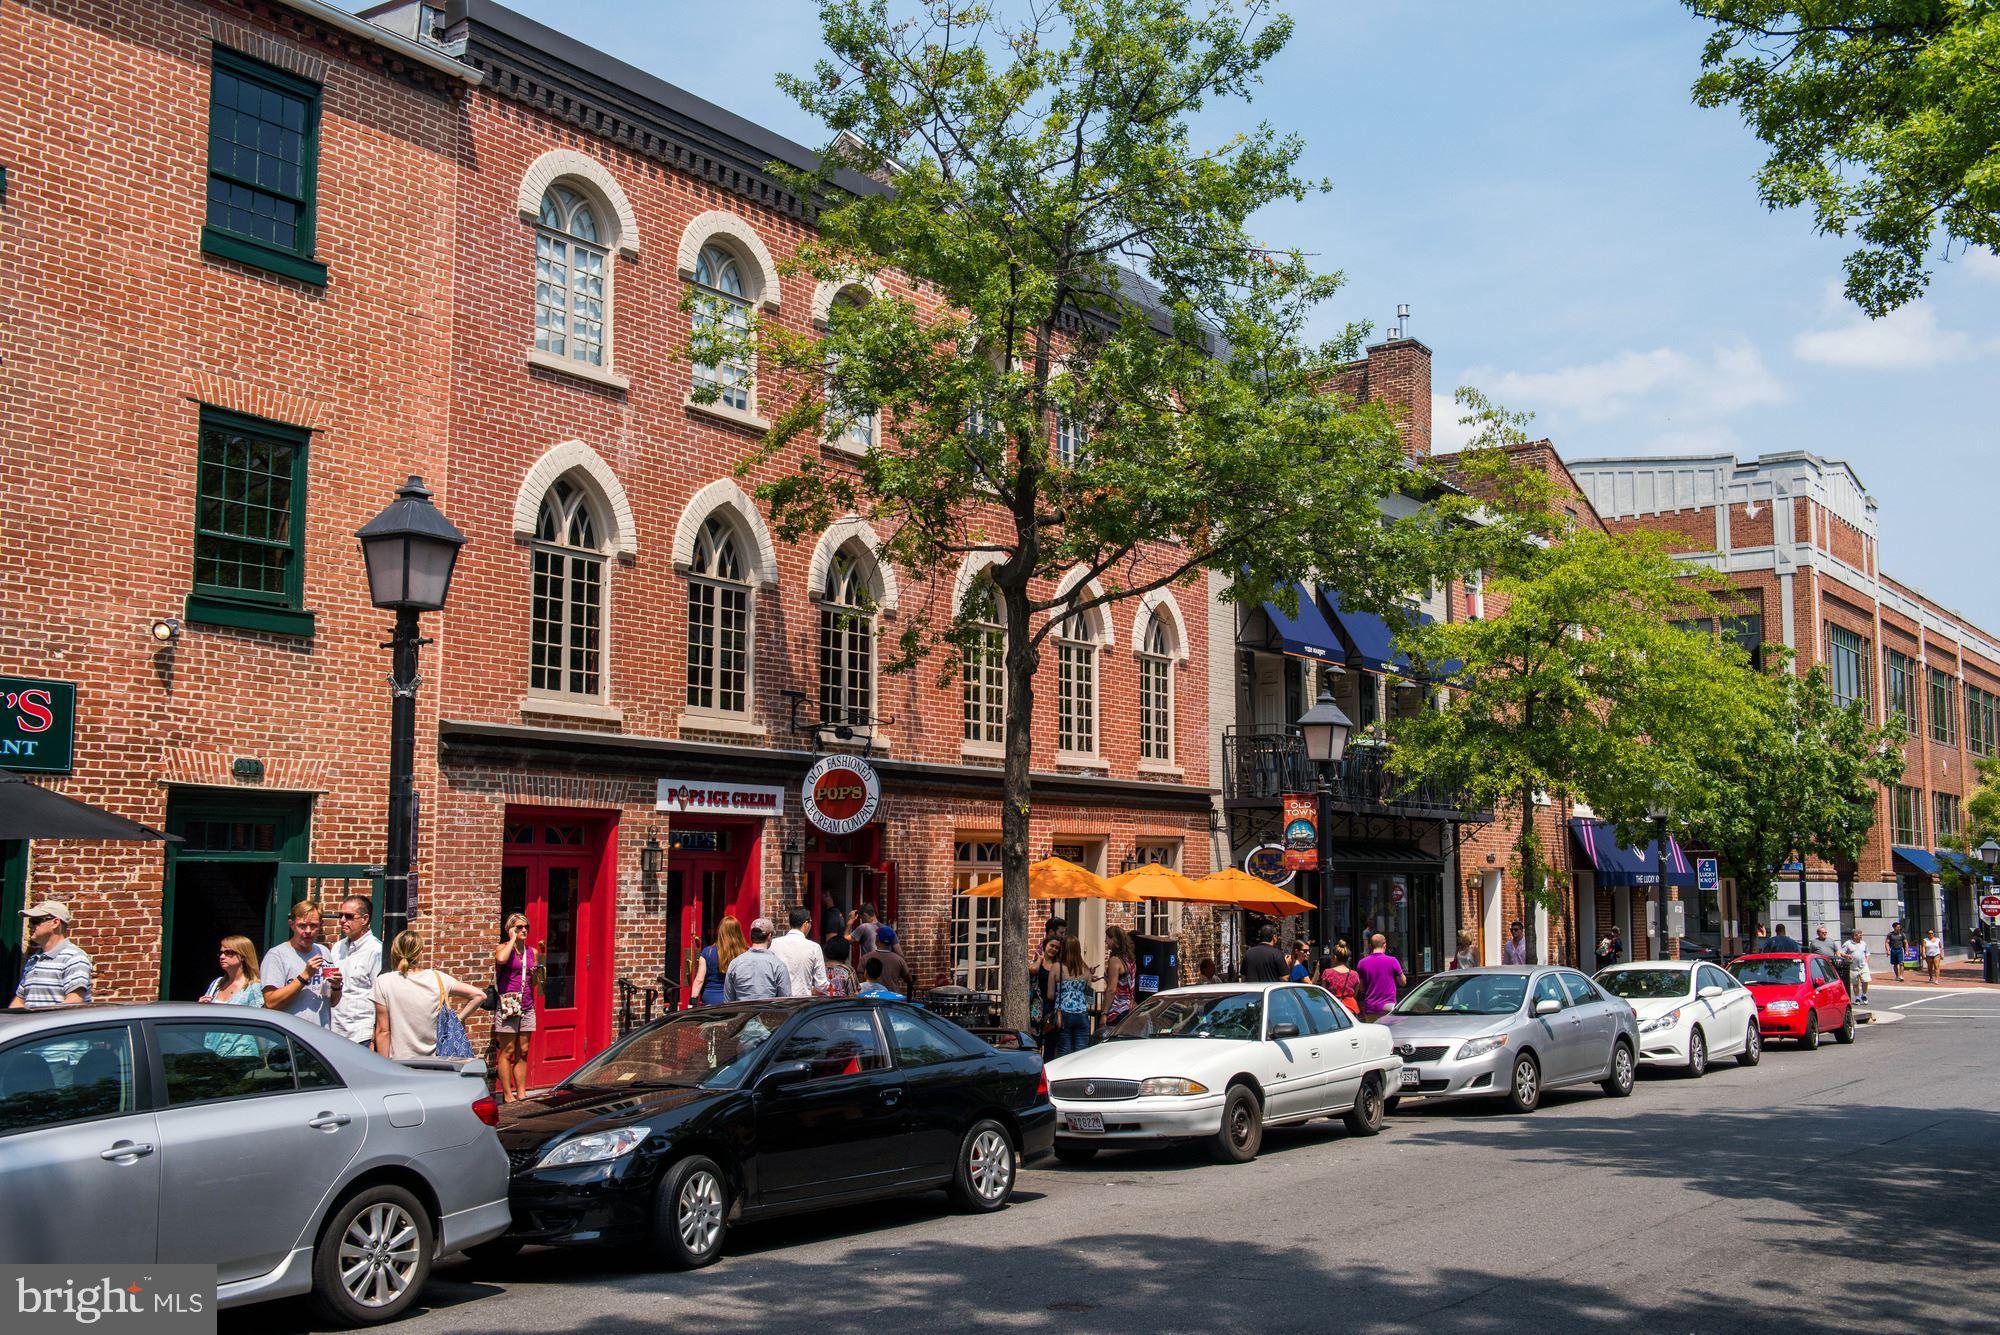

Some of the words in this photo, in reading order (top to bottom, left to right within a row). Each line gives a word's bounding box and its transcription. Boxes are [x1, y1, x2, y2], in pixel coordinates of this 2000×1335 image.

[0, 689, 53, 732] 'S
[0, 739, 39, 755] NT
[808, 764, 824, 785] OLD
[826, 755, 872, 782] FASHIONED
[708, 790, 729, 807] ICE
[732, 792, 777, 808] CREAM
[815, 785, 863, 801] POP'S
[803, 795, 816, 816] ICE
[812, 811, 840, 832] CREAM
[841, 792, 877, 832] COMPANY
[1635, 875, 1643, 883] THE
